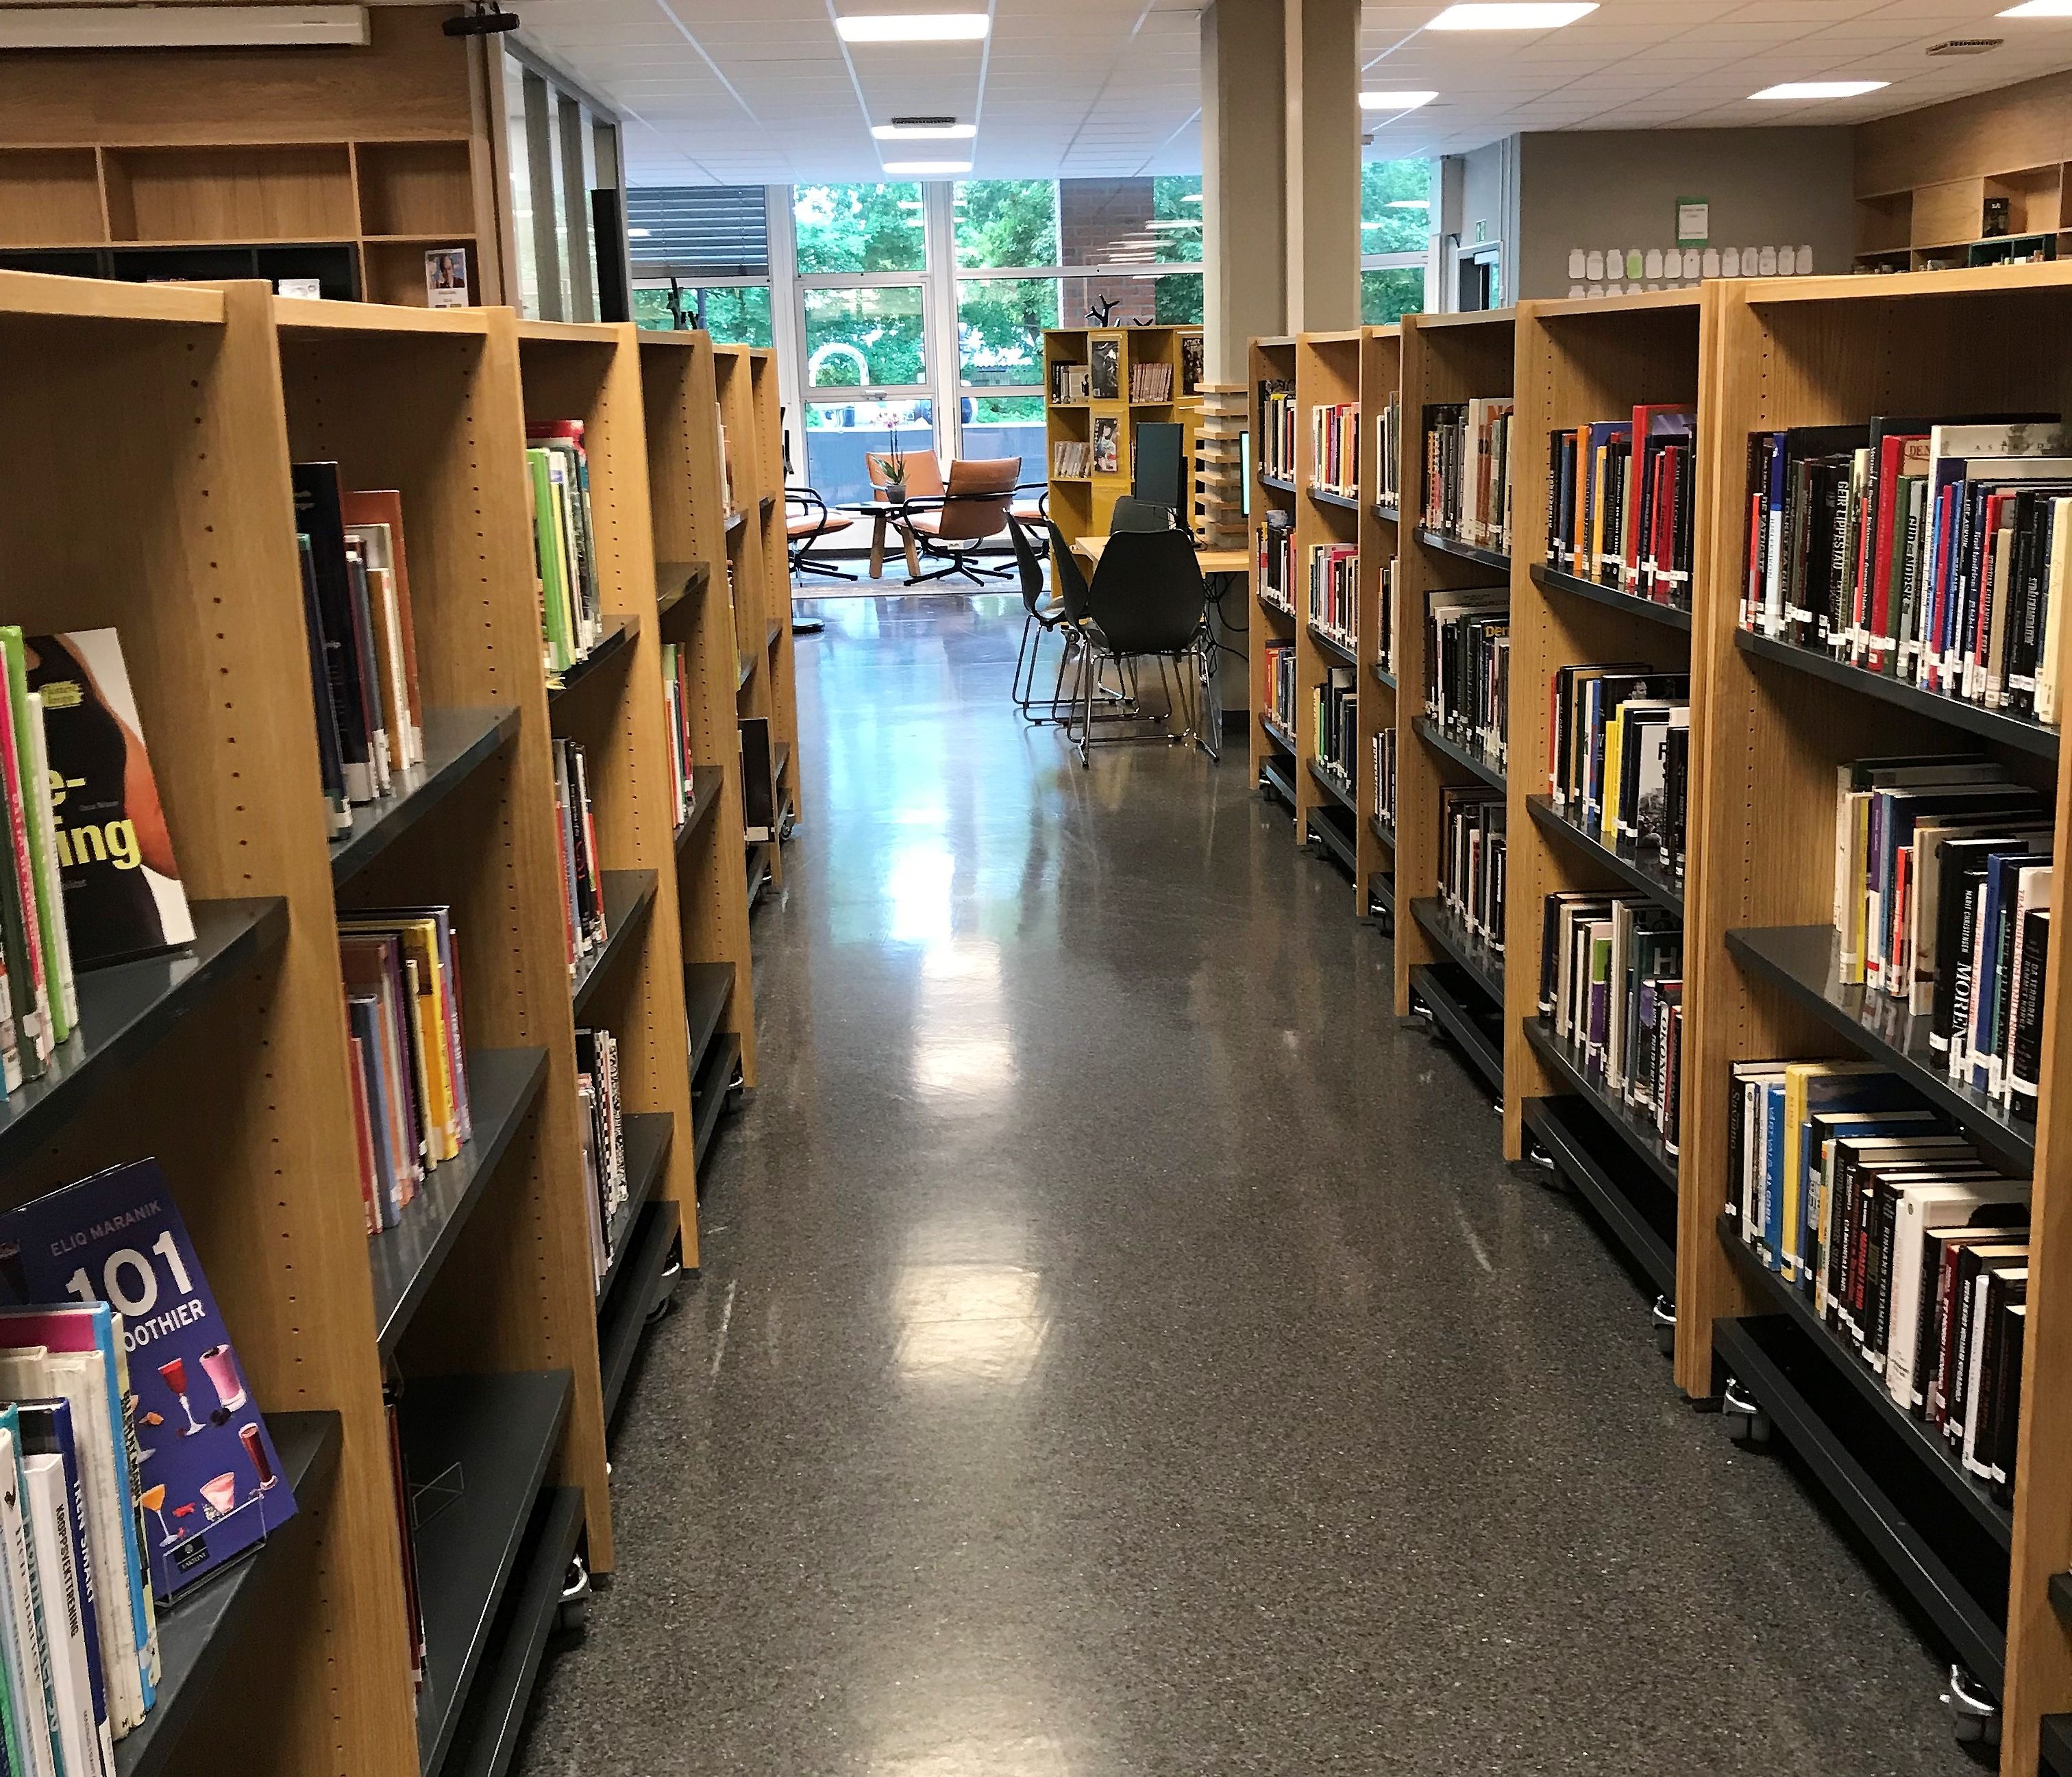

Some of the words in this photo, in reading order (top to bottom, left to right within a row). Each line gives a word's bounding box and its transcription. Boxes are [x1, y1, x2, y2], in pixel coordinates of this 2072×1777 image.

[1836, 481, 1849, 507] GEIR
[1767, 518, 1775, 579] JUSLEKSIKON
[1832, 509, 1847, 571] LIPPESTAD
[1964, 890, 1973, 910] MARIT
[2015, 889, 2025, 949] TRAGEDIEN
[1961, 910, 1971, 954] CHRISTENSEN
[1951, 960, 1973, 1041] MOREN
[51, 1231, 88, 1257] ELIQ
[89, 1200, 162, 1241] MARANIK
[1881, 1226, 1891, 1276] RINNANS
[66, 1230, 194, 1317] 101
[56, 1504, 79, 1639] KROPPSVEKTTRENING
[80, 1534, 95, 1604] SMART
